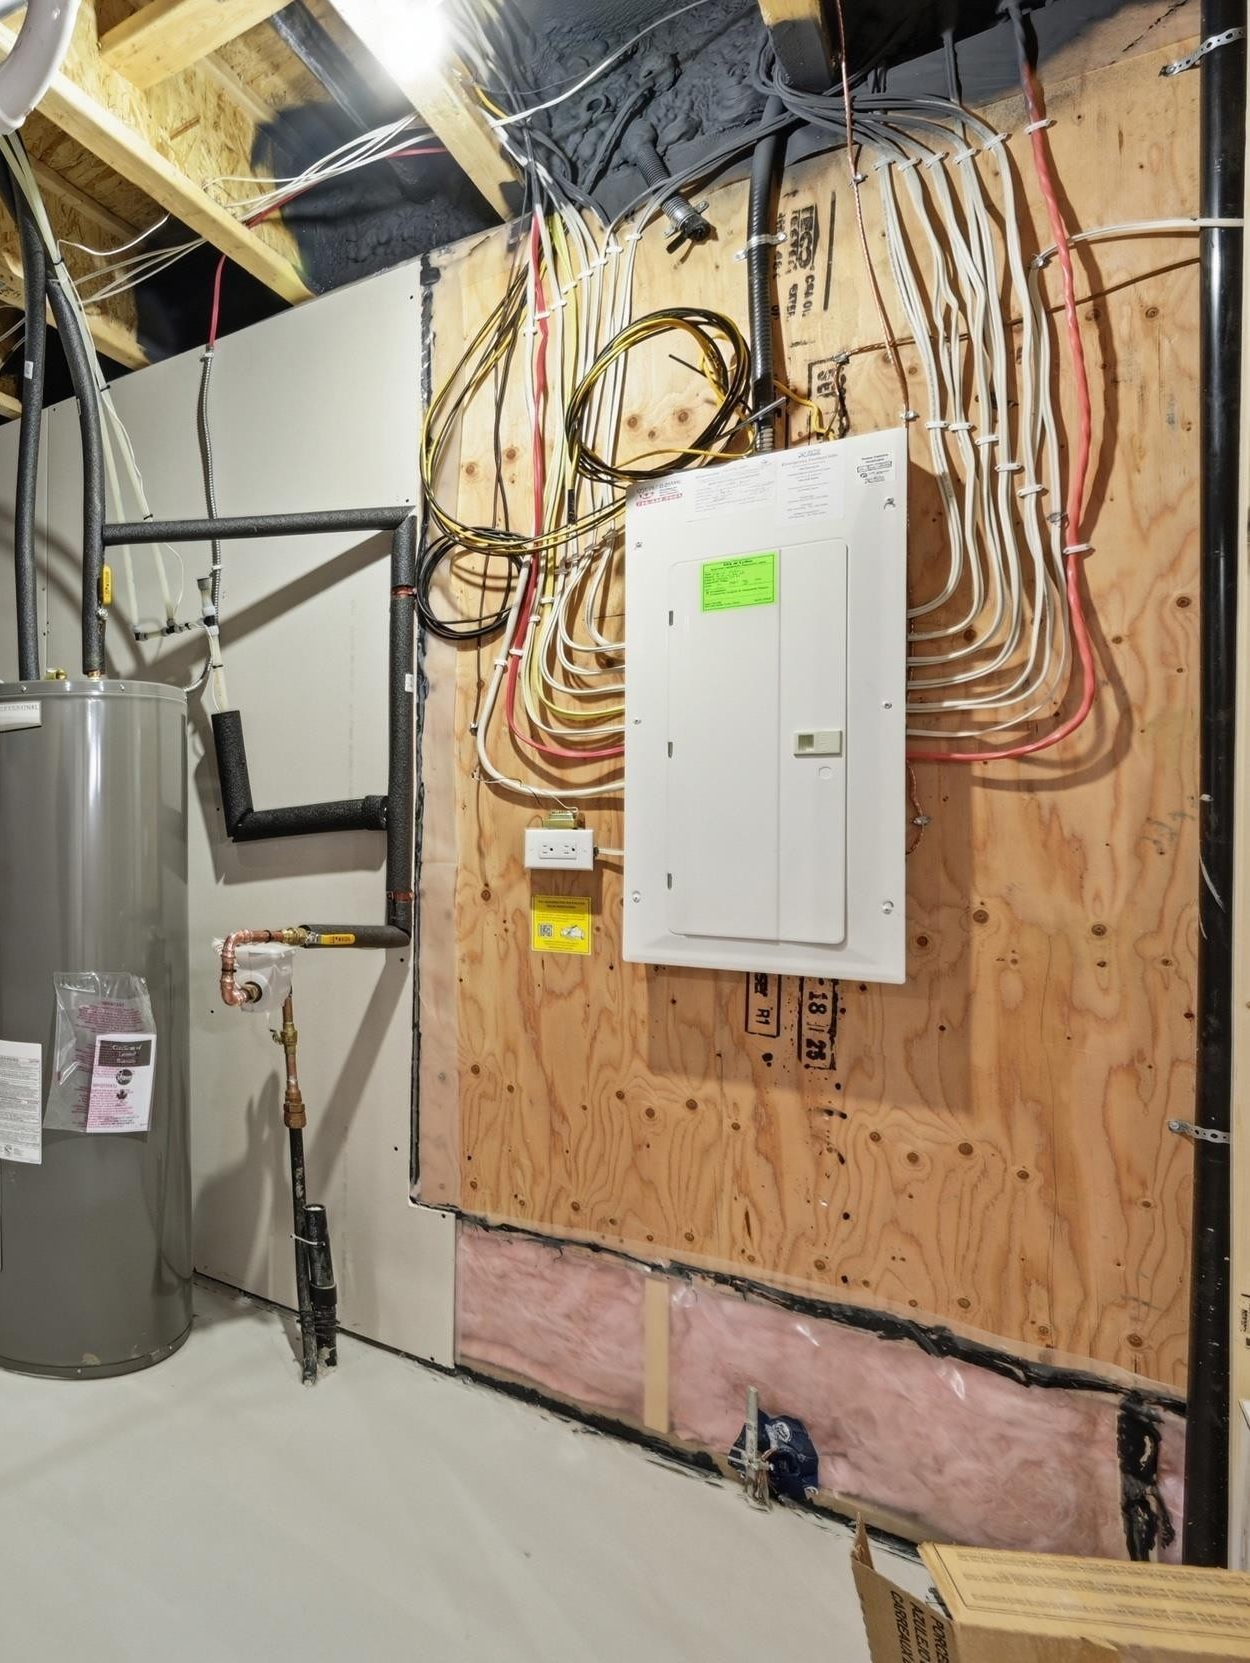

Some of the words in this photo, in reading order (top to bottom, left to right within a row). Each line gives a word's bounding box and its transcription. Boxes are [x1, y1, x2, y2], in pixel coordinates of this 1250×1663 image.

[755, 1008, 770, 1025] R1
[808, 991, 828, 1014] 18
[890, 1590, 914, 1660] CARREAUX
[910, 1600, 931, 1661] AZULEJO
